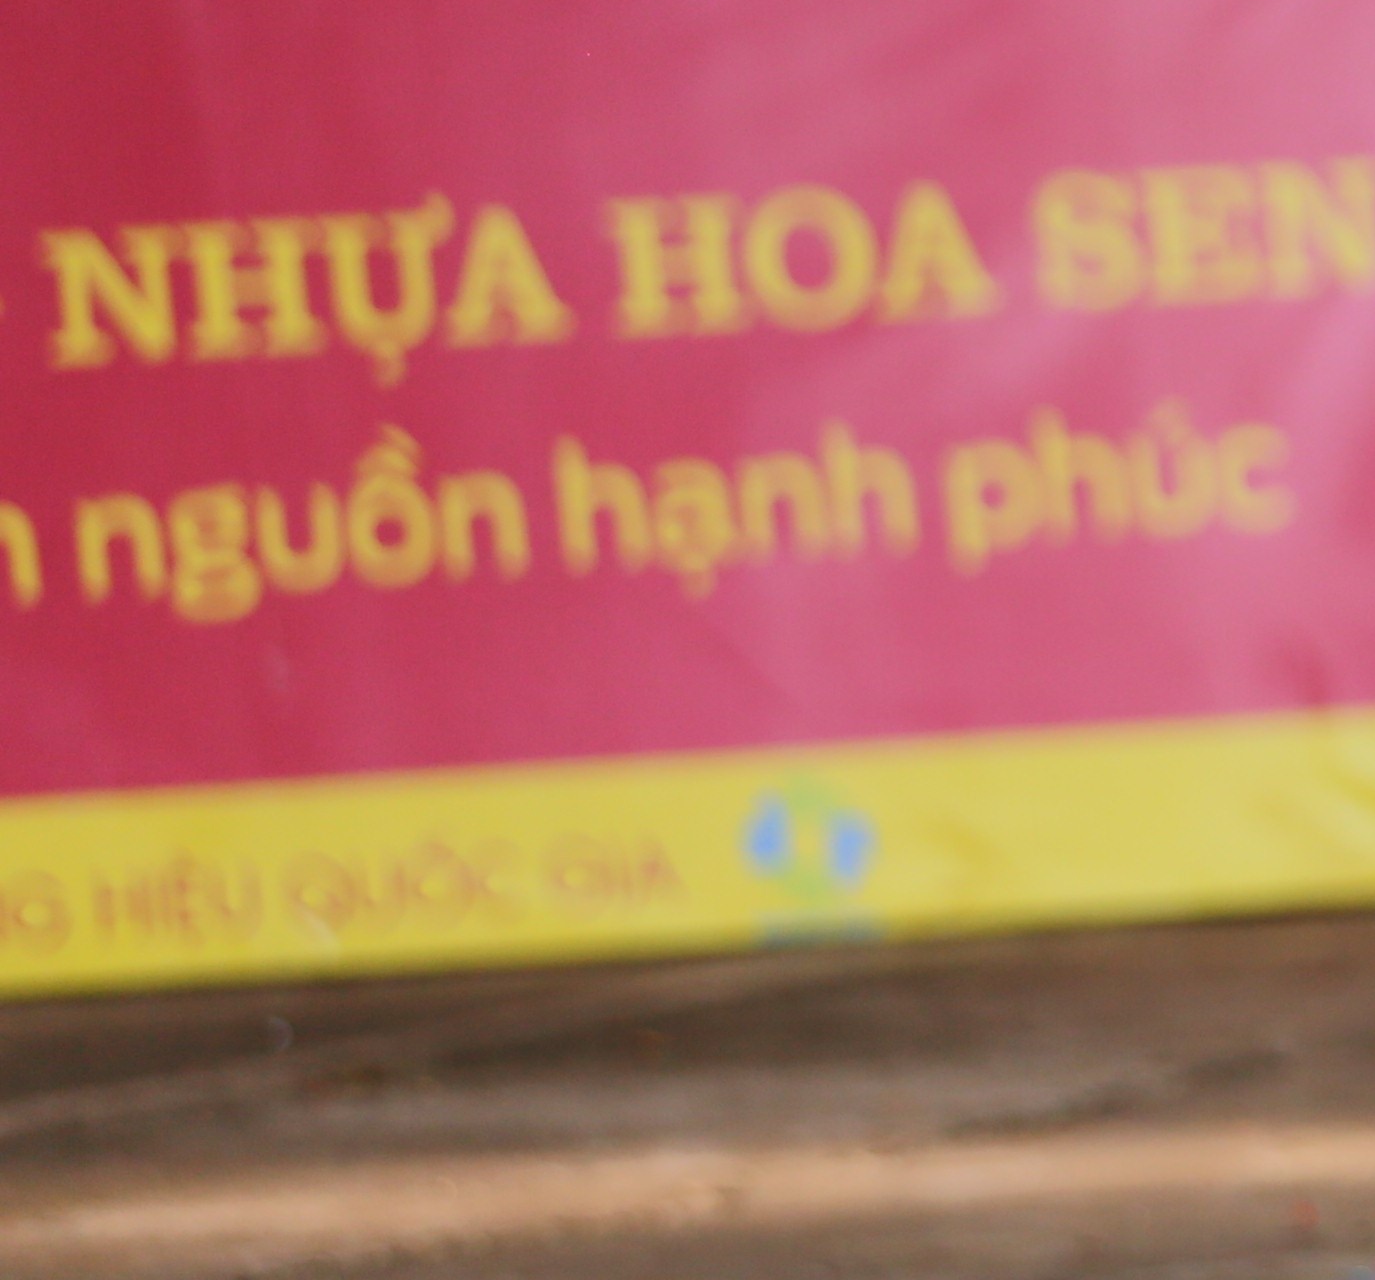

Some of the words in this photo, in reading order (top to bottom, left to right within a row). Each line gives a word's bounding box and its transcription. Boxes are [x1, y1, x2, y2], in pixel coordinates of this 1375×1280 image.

[42, 193, 572, 388] NHỰA
[606, 179, 1000, 340] HOA
[74, 424, 530, 623] nguồn
[555, 420, 917, 600] hạnh
[945, 398, 1298, 576] phúc
